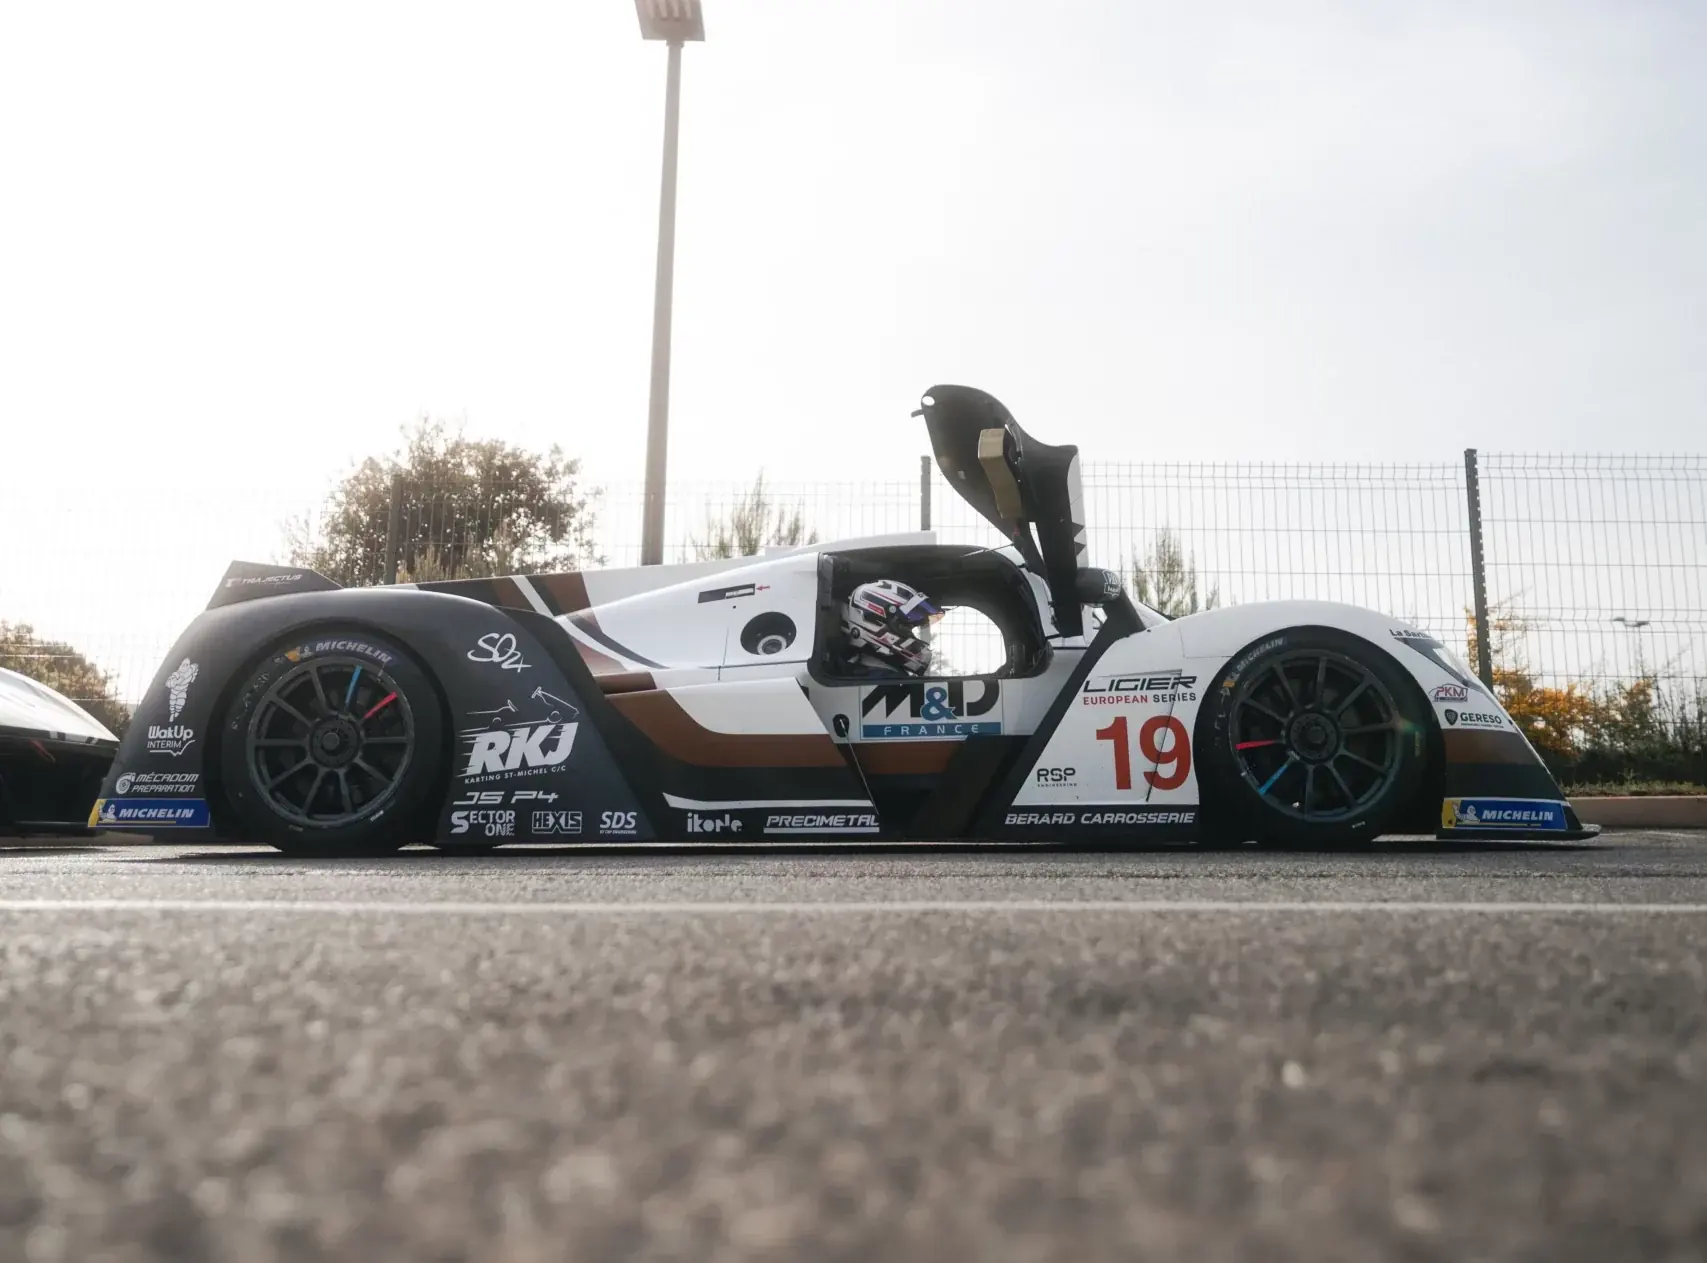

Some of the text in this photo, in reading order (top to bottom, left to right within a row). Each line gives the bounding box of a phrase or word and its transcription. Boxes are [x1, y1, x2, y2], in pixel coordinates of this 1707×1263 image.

[1389, 628, 1404, 637] La
[316, 640, 392, 663] MICHELIN
[1237, 636, 1284, 672] MICHELIN
[1083, 676, 1197, 693] LIGIER
[1436, 686, 1465, 697] PKM
[1083, 692, 1197, 705] EUROPEAN SERIES
[1460, 712, 1502, 725] GERESO
[147, 725, 194, 740] WakUp
[884, 724, 979, 736] FRANCE
[147, 740, 182, 749] INTERIM
[457, 722, 579, 777] RKJ
[1096, 715, 1191, 790] 19
[135, 771, 200, 783] MÉCADOM
[464, 764, 567, 784] KARTING ST-MICHEL C/C
[1037, 767, 1076, 783] RSP
[131, 784, 195, 793] PREPARATION
[453, 790, 559, 805] JS P4
[119, 808, 195, 818] MICHELIN
[1005, 812, 1196, 825] BERARD CARROSSERIE
[1482, 809, 1554, 821] MICHELIN
[450, 810, 516, 834] SECTOR
[532, 811, 582, 834] HEXIS
[600, 811, 637, 829] SDS
[766, 814, 880, 827] PRECIMETAL
[485, 823, 515, 836] ONE
